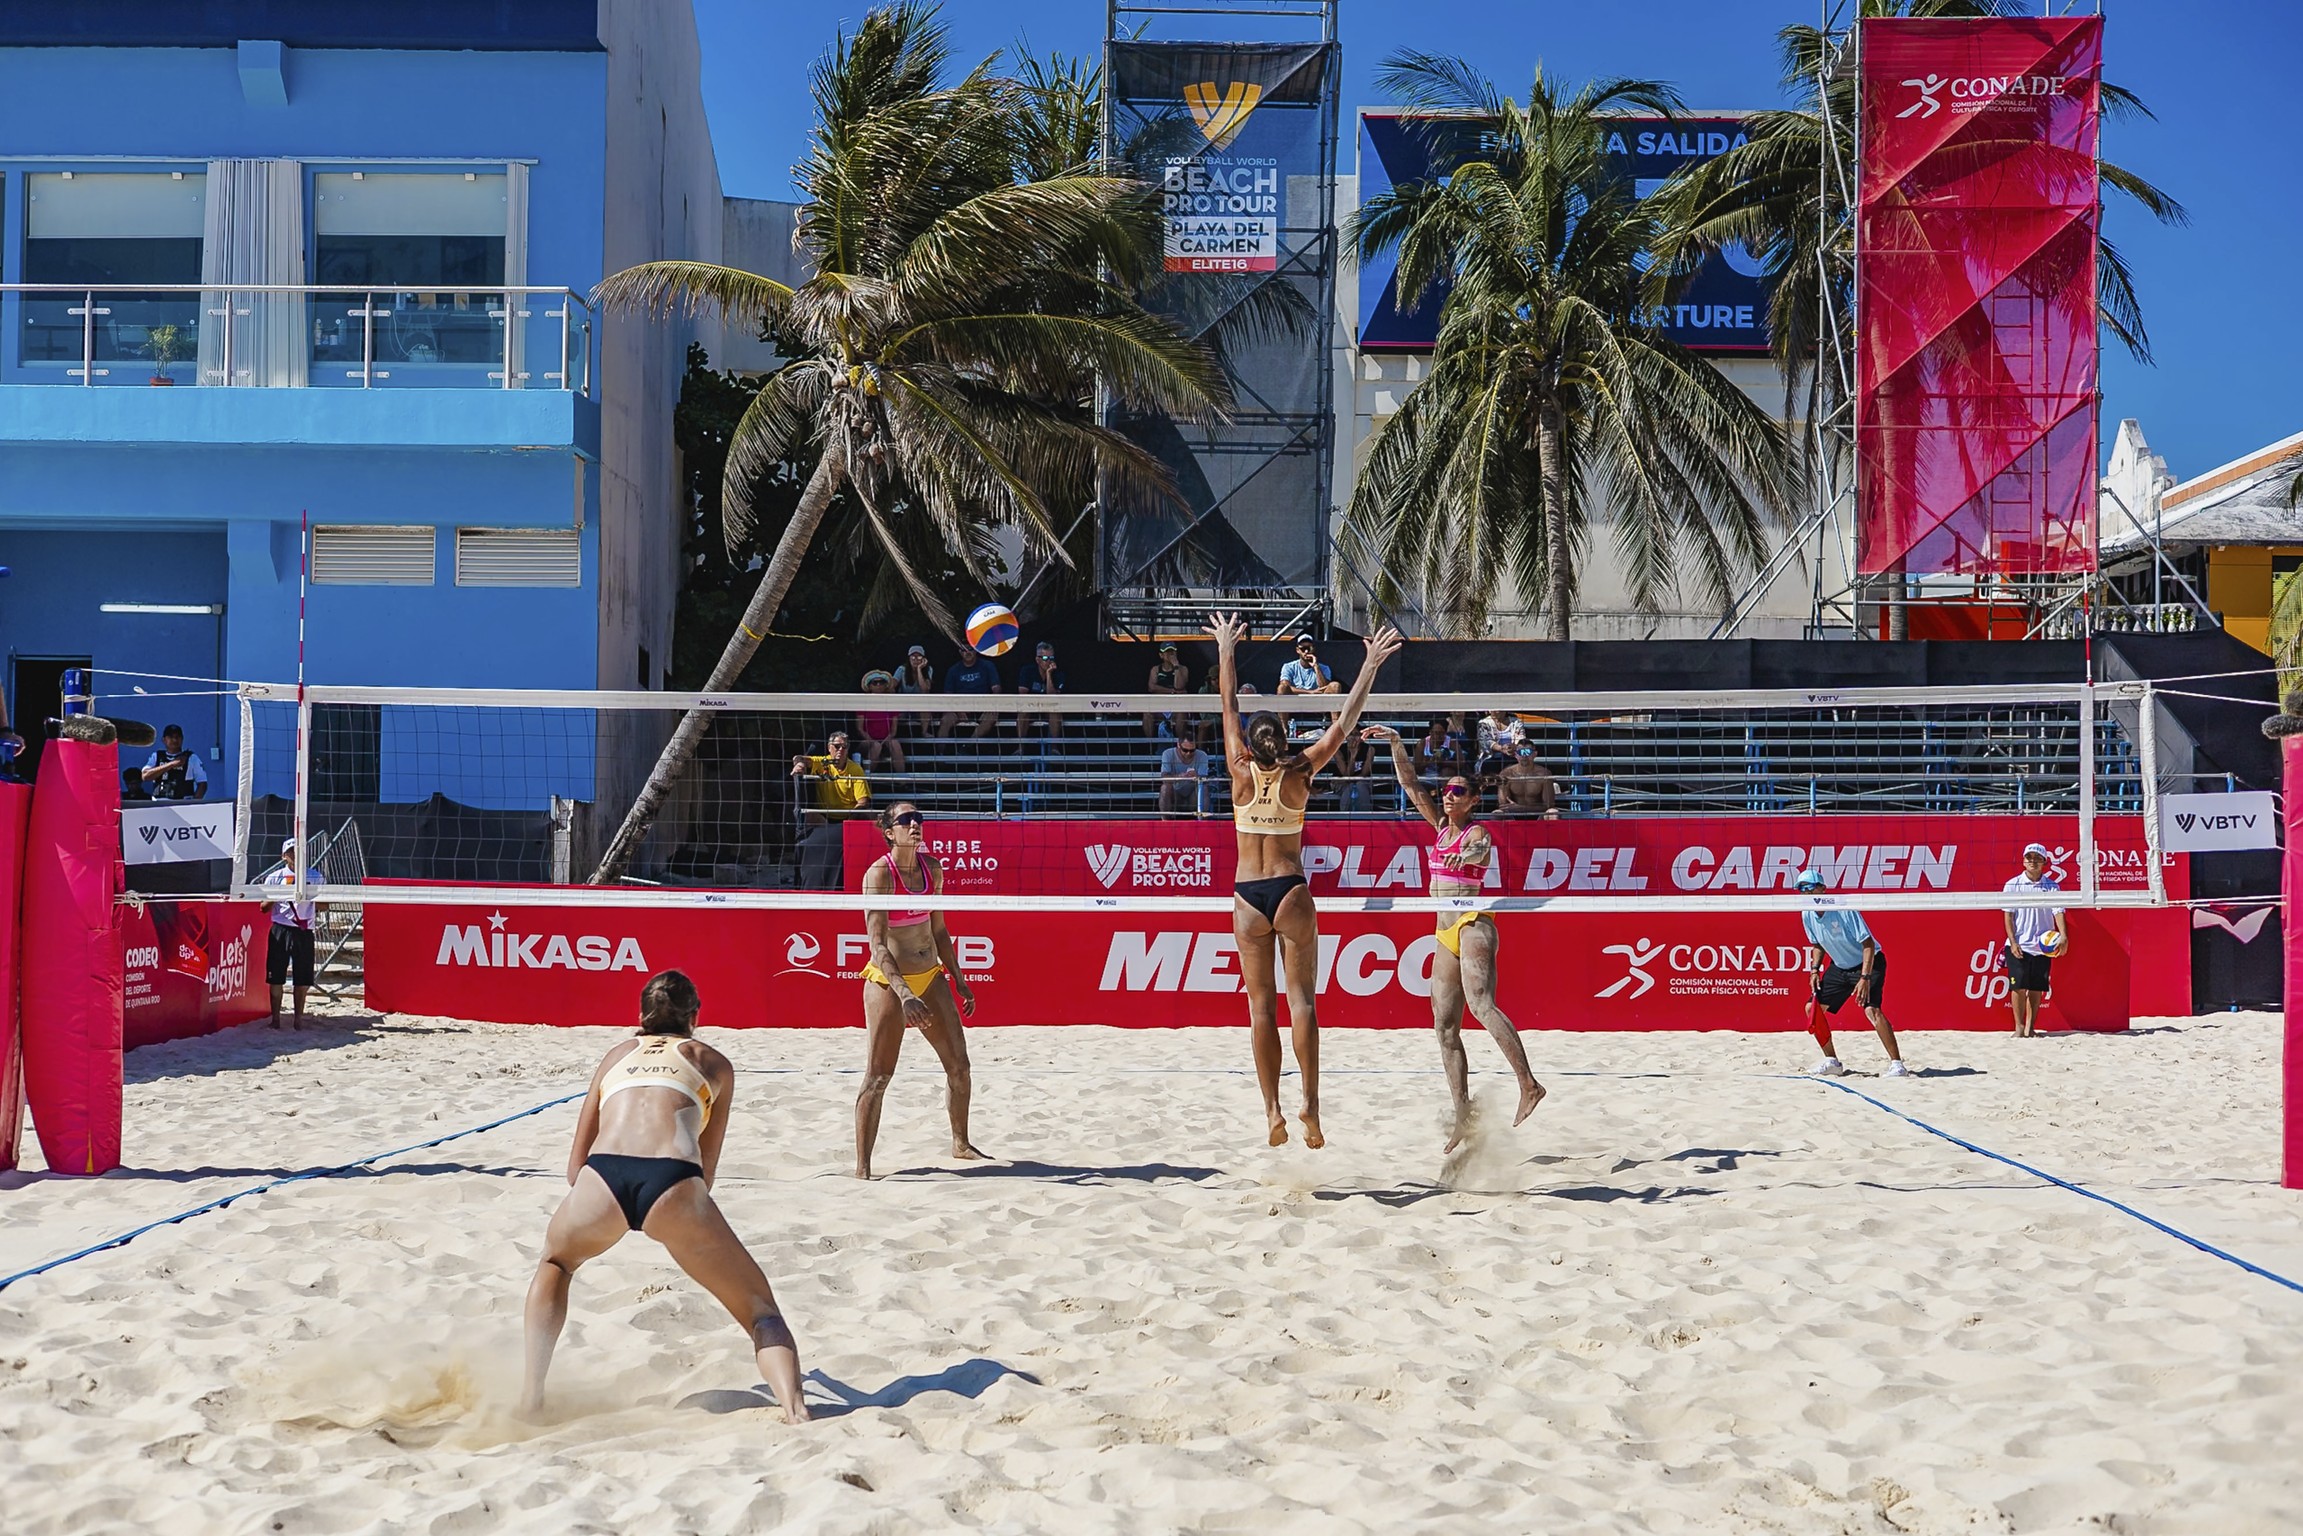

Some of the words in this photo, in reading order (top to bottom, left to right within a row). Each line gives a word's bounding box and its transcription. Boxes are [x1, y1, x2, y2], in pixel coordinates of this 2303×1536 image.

[1951, 76, 2066, 97] CONADE
[1166, 157, 1233, 165] VOLLEYBALL
[1236, 158, 1277, 166] WORLD
[1165, 167, 1277, 193] BEACH
[1164, 195, 1211, 213] PRO
[1214, 196, 1277, 213] TOUR
[1172, 222, 1229, 236] PLAYA
[1235, 222, 1269, 236] DEL
[1180, 239, 1260, 253] CARMEN
[1192, 259, 1247, 270] ELITE16
[1263, 786, 1269, 796] 1
[2200, 815, 2257, 830] VBTV
[163, 825, 218, 841] VBTV
[916, 840, 981, 853] ARIBE
[940, 857, 998, 870] CANO
[1133, 855, 1211, 872] BEACH
[1523, 847, 1648, 890] DEL
[1671, 845, 1957, 890] CARMEN
[961, 877, 993, 885] paradise
[1133, 874, 1166, 886] PRO
[1168, 874, 1211, 886] TOUR
[126, 946, 159, 969] CODEQ
[963, 974, 994, 982] LEIBOL
[1670, 977, 1712, 986] COMISIÓN
[1711, 985, 1739, 995] FÍSICA
[1965, 975, 2010, 1008] up
[642, 1066, 679, 1074] VBTV
